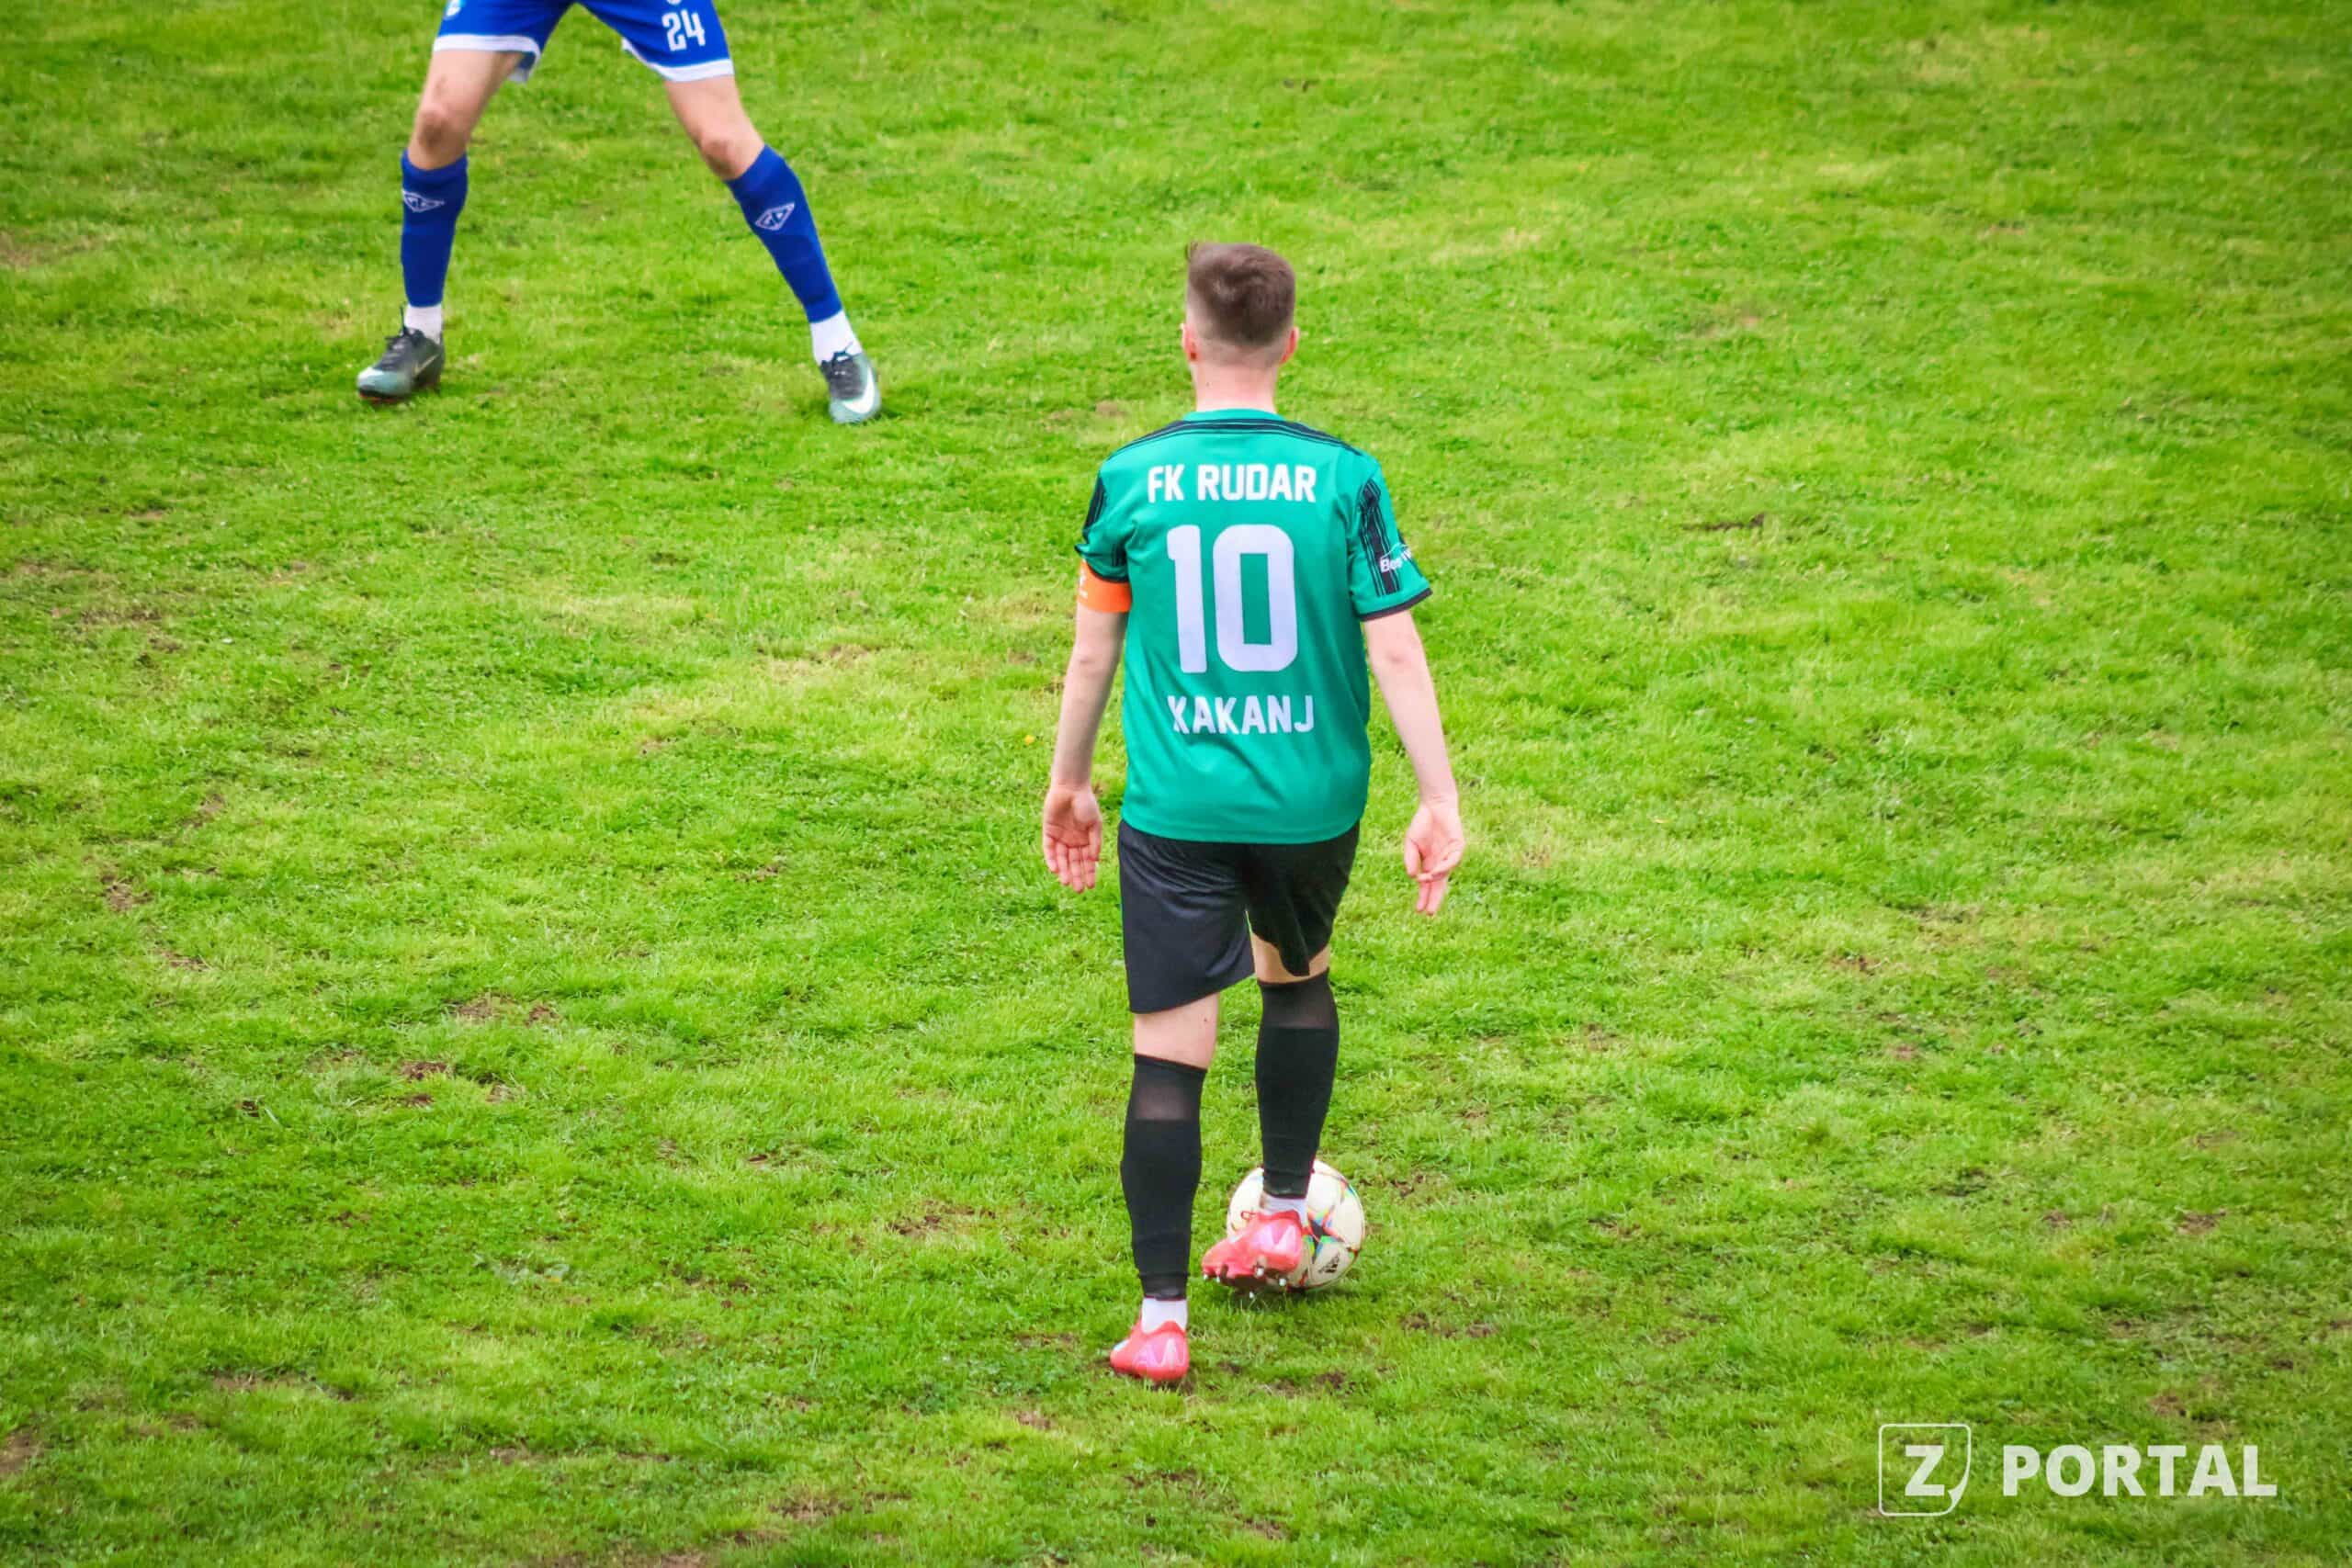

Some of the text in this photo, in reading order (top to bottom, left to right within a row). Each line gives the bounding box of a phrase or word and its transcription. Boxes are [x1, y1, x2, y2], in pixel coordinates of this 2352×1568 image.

[662, 9, 706, 51] 24
[1148, 463, 1317, 503] FK RUDAR
[1166, 524, 1298, 673] 10
[1167, 694, 1315, 735] KAKANJ
